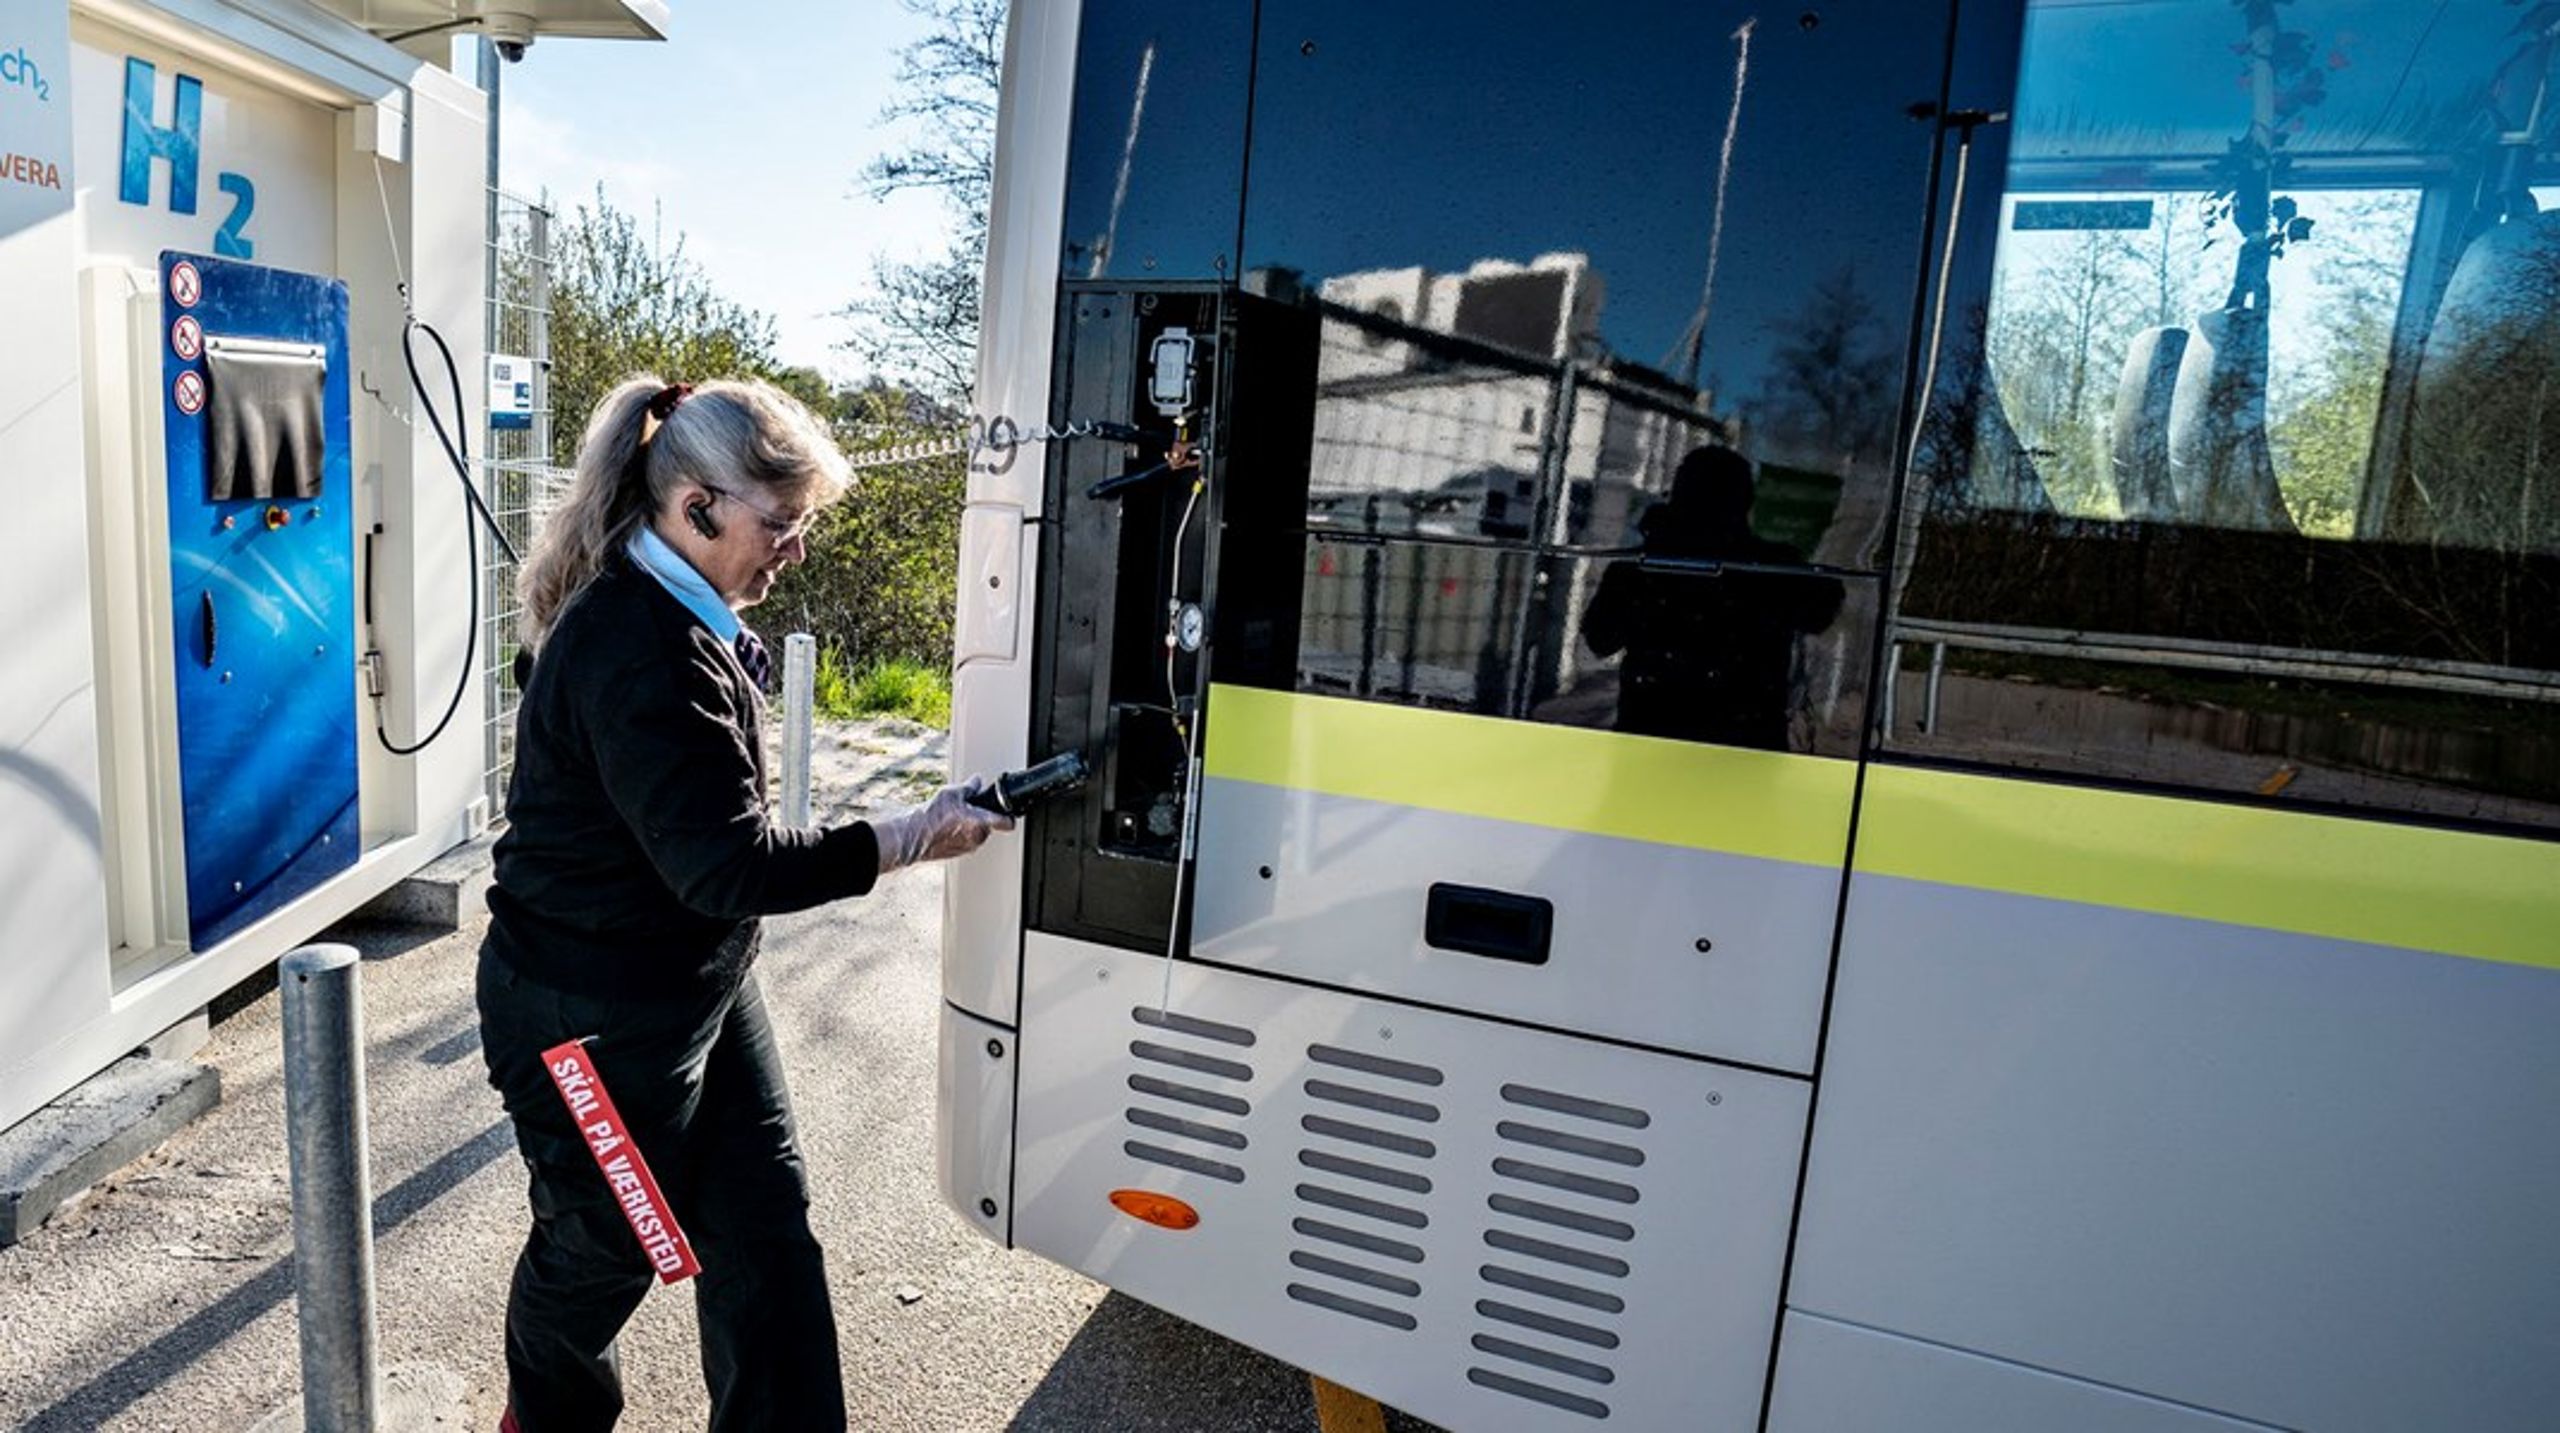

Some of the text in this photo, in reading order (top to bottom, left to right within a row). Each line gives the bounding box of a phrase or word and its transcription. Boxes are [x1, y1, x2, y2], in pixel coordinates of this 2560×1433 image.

[970, 414, 1018, 476] 29
[554, 1057, 683, 1274] SKAL PÅ VÆRKSTED
